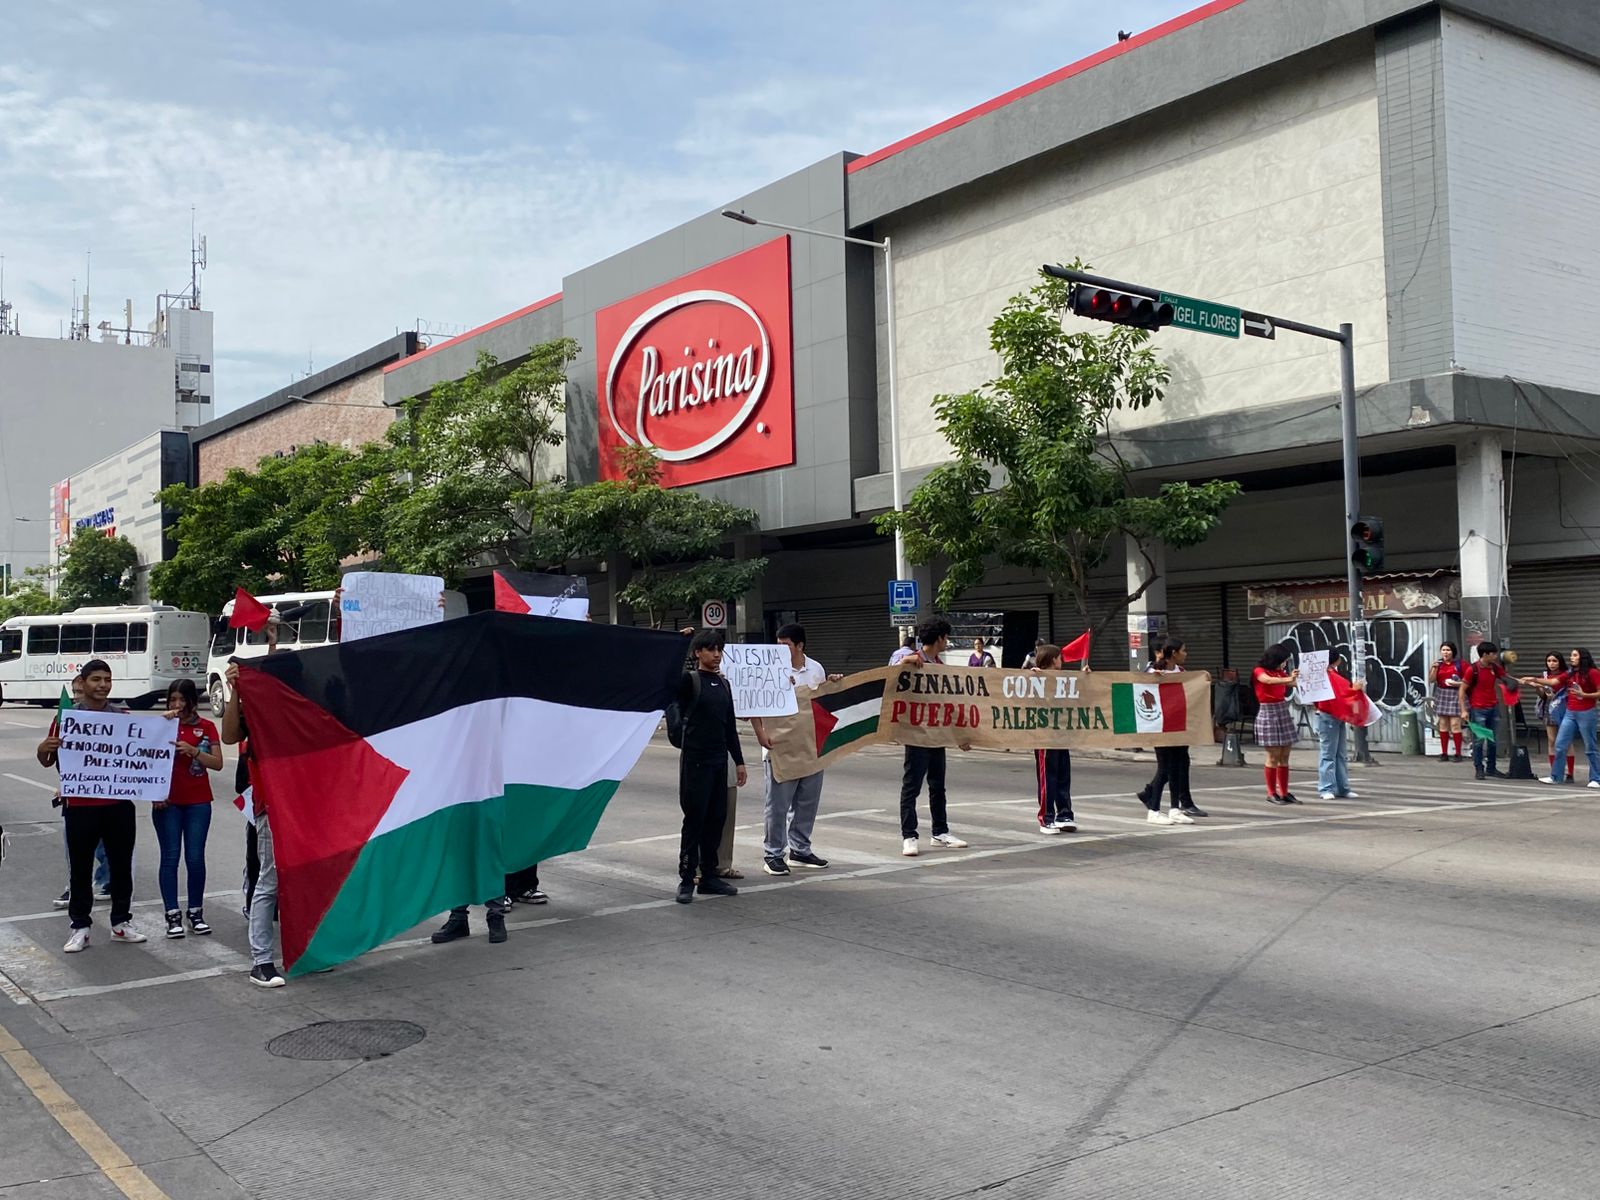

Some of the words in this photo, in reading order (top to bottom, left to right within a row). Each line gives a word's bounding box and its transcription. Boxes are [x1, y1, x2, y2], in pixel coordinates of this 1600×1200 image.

[1164, 296, 1178, 304] CALLE
[1171, 304, 1197, 325] NGEL
[1199, 310, 1237, 333] FLORES
[636, 337, 758, 424] Parisina
[709, 607, 720, 618] 30
[1299, 594, 1388, 615] CATEDAL
[722, 645, 742, 665] NO
[745, 648, 761, 666] ES
[762, 648, 783, 666] UNA
[28, 661, 67, 676] redplus
[726, 666, 778, 690] GUERRA
[778, 667, 792, 692] ES
[896, 671, 990, 697] SINALOA
[1002, 675, 1047, 699] CON
[1054, 676, 1080, 699] EL
[890, 700, 980, 728] PUEBLO
[991, 705, 1109, 730] PALESTINA
[127, 722, 145, 739] EL
[60, 735, 123, 755] GENOCIDIO
[125, 741, 171, 759] CONTRA
[63, 785, 75, 794] EN
[77, 785, 91, 794] PIE
[93, 784, 105, 795] DE
[113, 774, 167, 784] ESTUDIANTES
